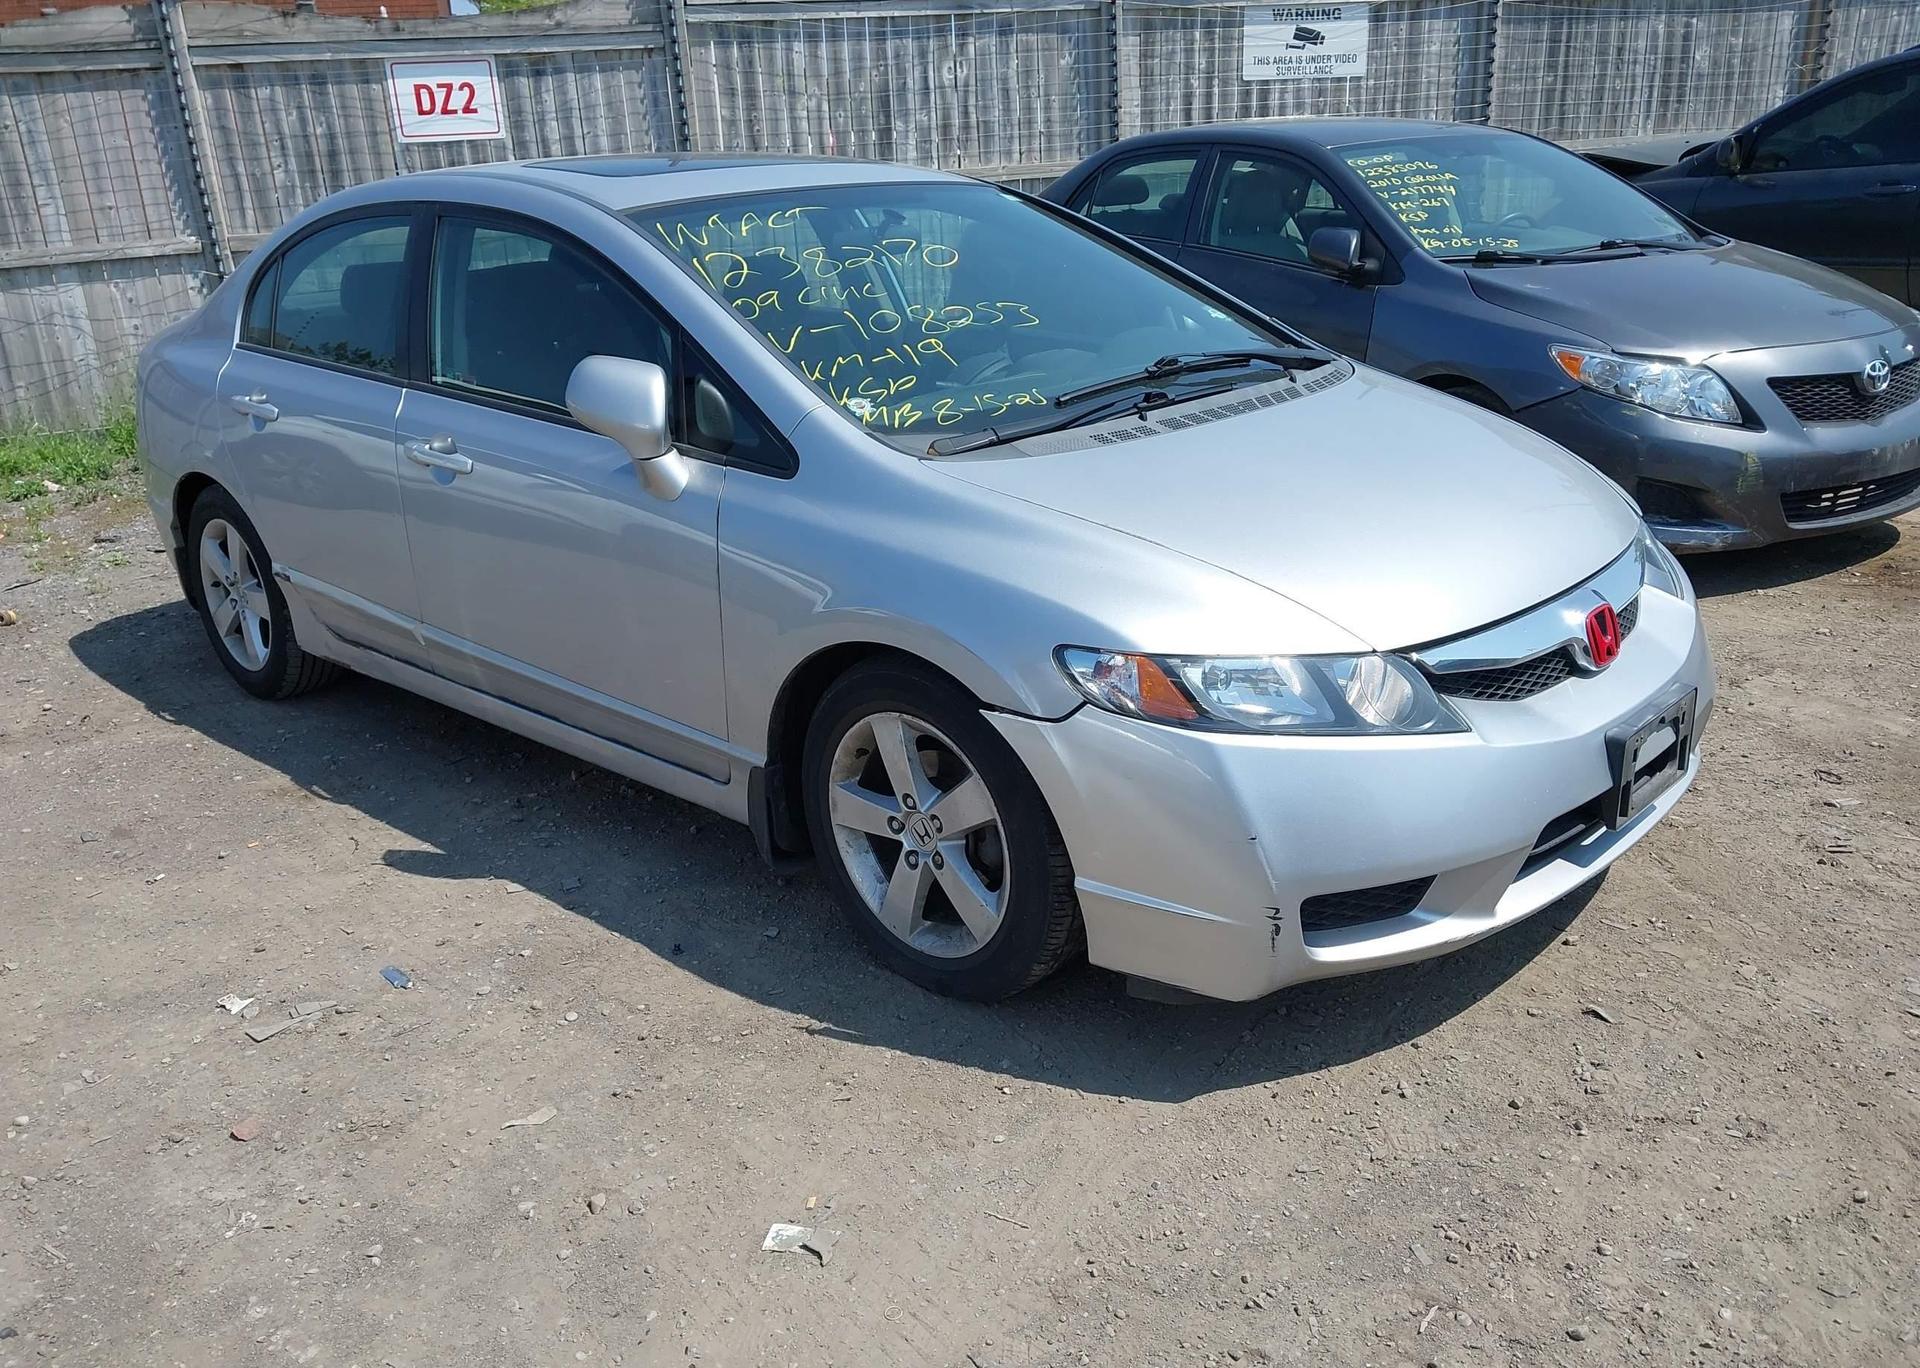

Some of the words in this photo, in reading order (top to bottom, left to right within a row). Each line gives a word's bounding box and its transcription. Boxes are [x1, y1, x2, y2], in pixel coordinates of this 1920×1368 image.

[1272, 8, 1342, 21] WARNING
[1253, 55, 1271, 66] THIS
[1272, 55, 1294, 65] AREA
[1295, 54, 1303, 65] IS
[1305, 54, 1332, 65] UNDER
[1334, 53, 1357, 64] VIDEO
[1275, 64, 1334, 76] SURVEILLANCE
[413, 82, 479, 116] DZ2
[1357, 161, 1439, 178] 12385096
